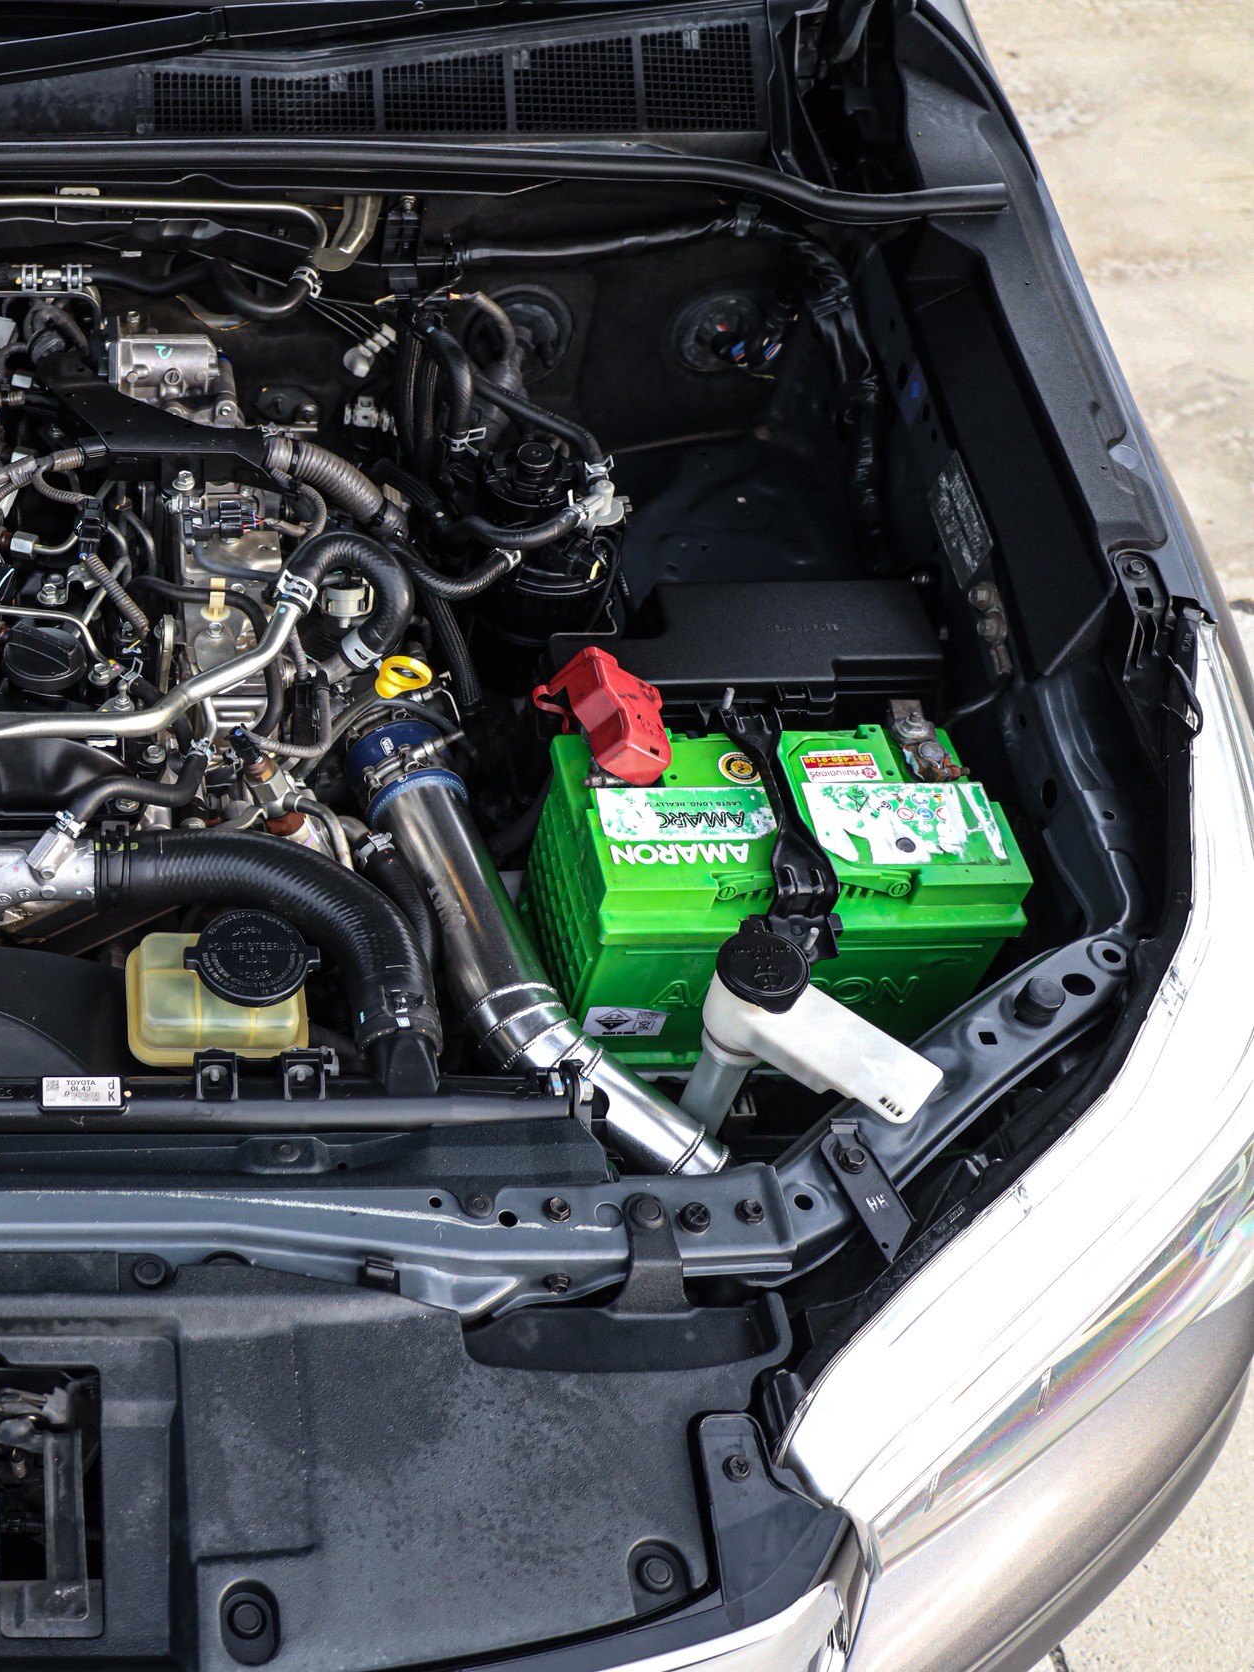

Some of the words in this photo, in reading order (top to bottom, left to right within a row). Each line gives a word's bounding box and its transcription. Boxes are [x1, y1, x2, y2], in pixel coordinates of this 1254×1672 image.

[653, 800, 685, 808] REALLY
[716, 800, 742, 808] LASTS
[609, 843, 750, 866] AMARON
[208, 942, 245, 952] POWER
[247, 941, 298, 952] STEERING
[239, 955, 269, 964] FLUID
